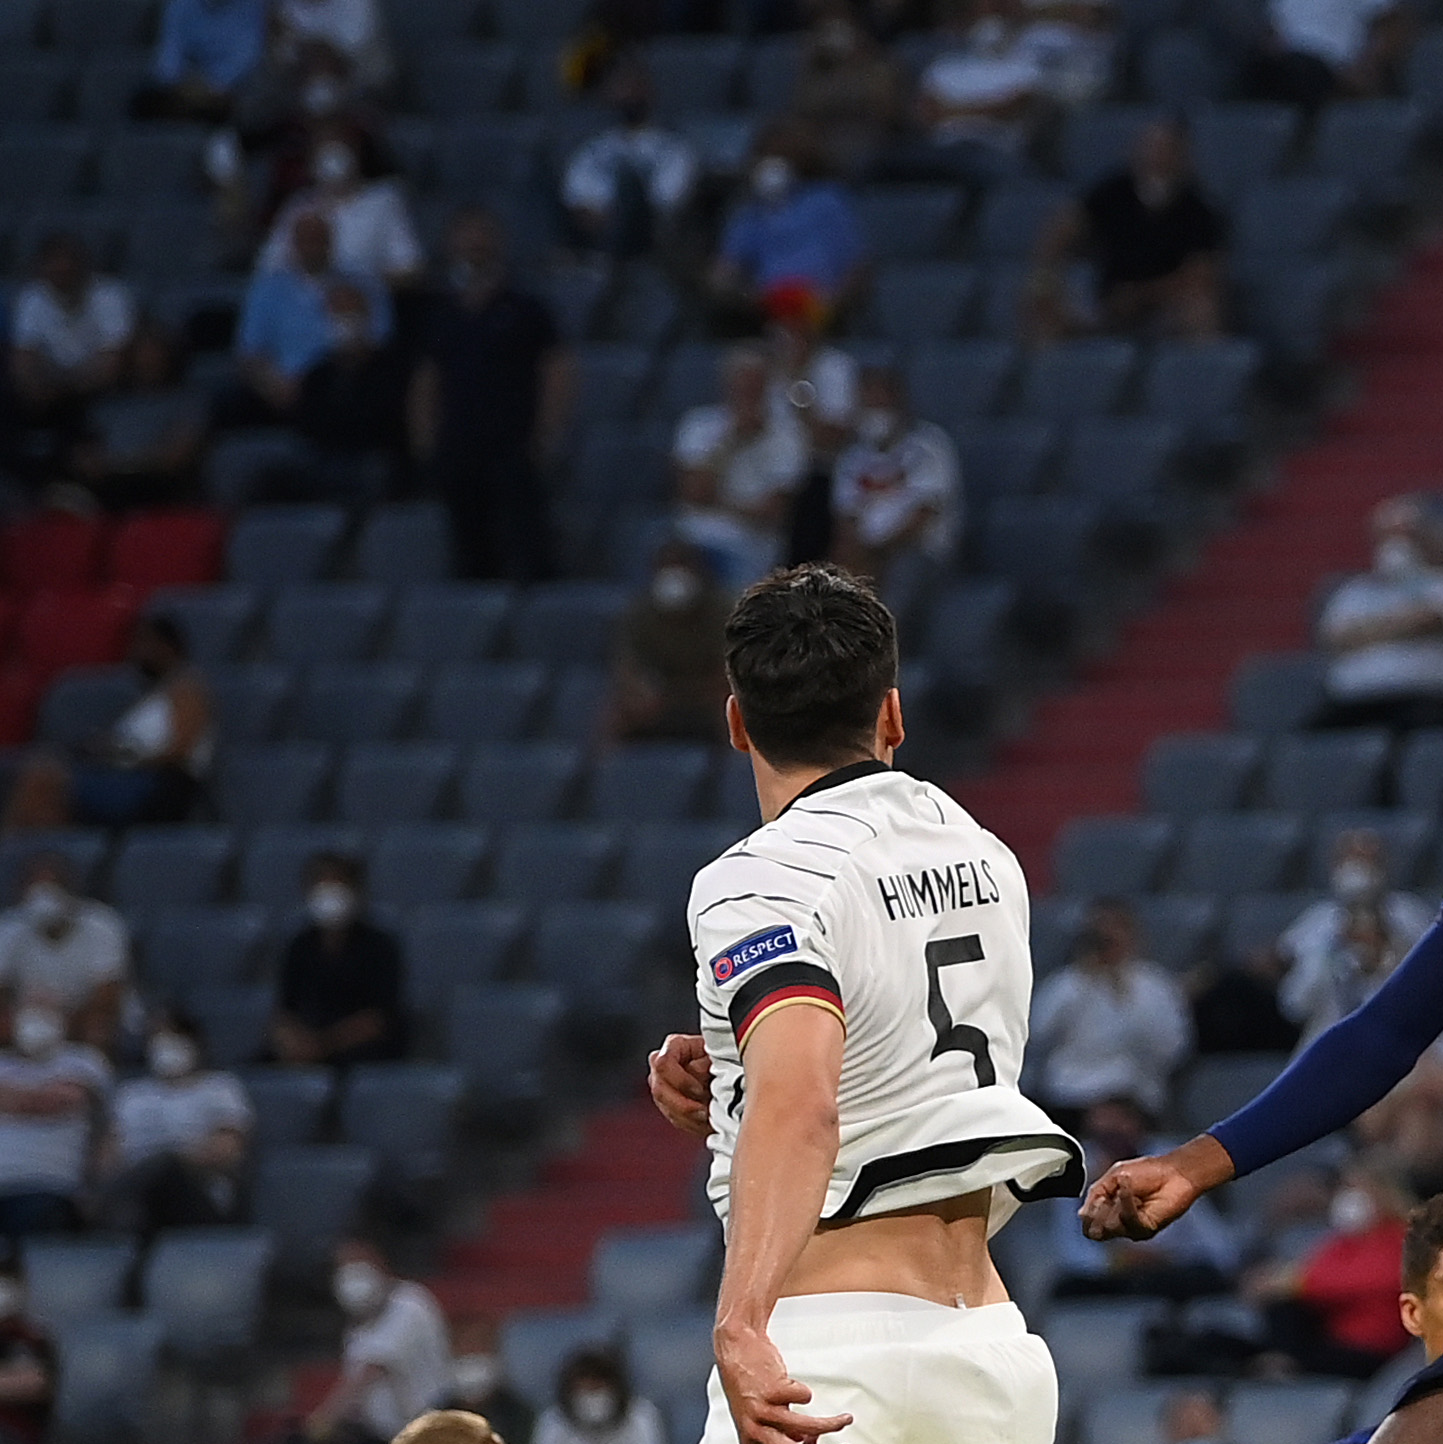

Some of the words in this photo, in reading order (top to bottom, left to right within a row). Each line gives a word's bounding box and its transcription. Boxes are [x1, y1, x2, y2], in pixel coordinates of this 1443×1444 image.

[877, 859, 1001, 921] HUMMELS
[732, 932, 793, 967] RESPECT
[925, 934, 997, 1089] 5
